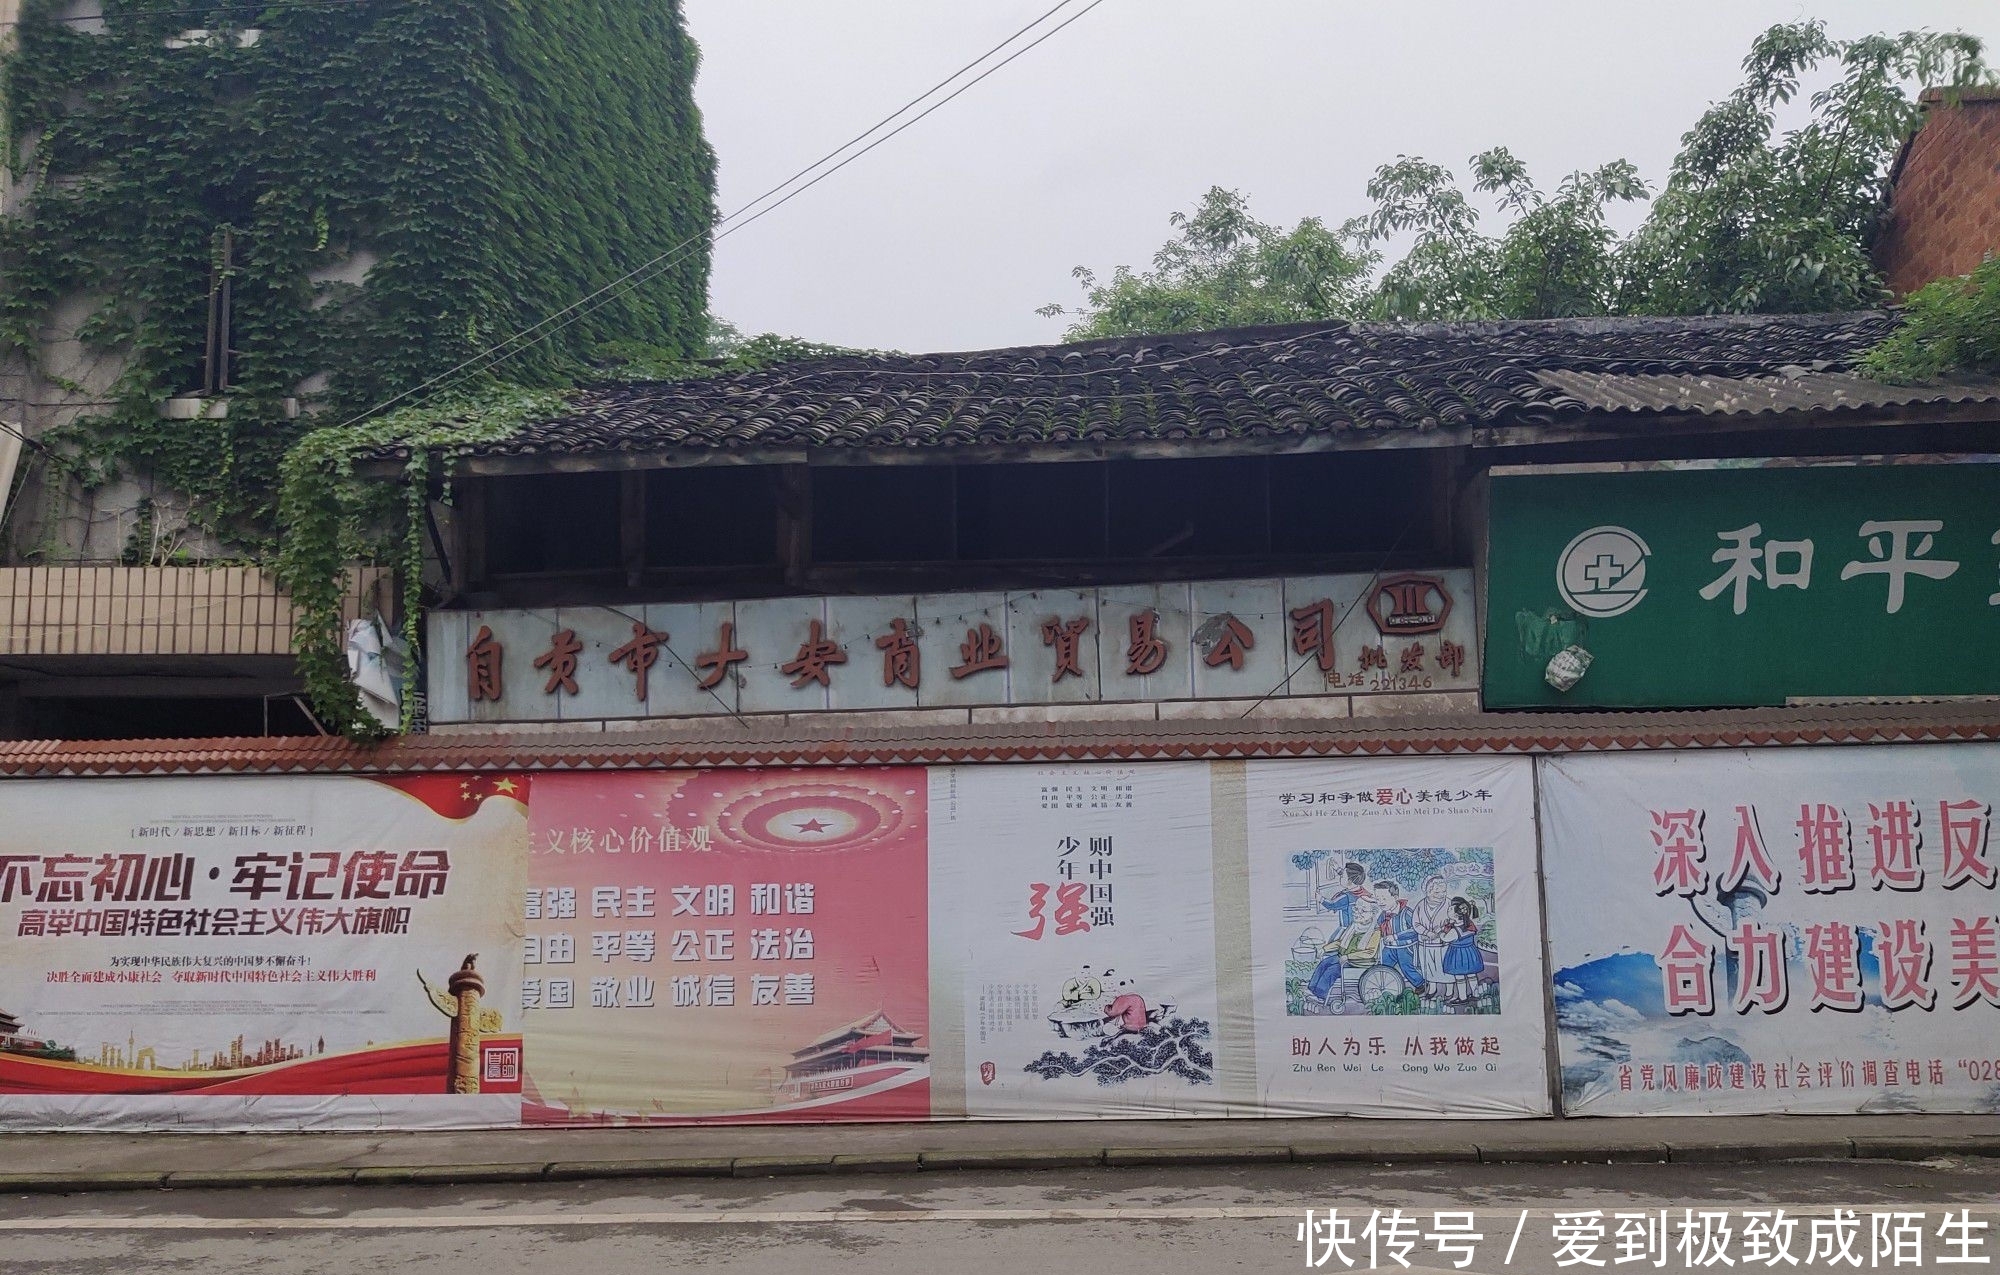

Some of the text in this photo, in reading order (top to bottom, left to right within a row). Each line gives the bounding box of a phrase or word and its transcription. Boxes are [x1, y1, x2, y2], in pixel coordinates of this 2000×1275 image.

[1699, 520, 2000, 615] 和平
[1325, 671, 1432, 691] 电话 221346
[1279, 788, 1493, 805] 学习和争做爱心美德少年
[1316, 809, 1328, 817] He
[1331, 809, 1359, 818] Zheng
[1361, 808, 1380, 816] Zuo
[1383, 808, 1393, 816] Ai
[1395, 807, 1411, 816] Xin
[1414, 807, 1430, 815] Mei
[1433, 807, 1445, 815] De
[1448, 806, 1469, 815] Shao
[1472, 806, 1494, 814] Nian
[138, 827, 171, 838] 新时代
[183, 826, 216, 837] 新思想
[229, 826, 261, 837] 新目标
[273, 825, 306, 837] 新征程
[1650, 799, 1995, 897] 深入推进反
[1056, 836, 1081, 880] 少年
[1090, 836, 1115, 926] 则中国强
[592, 886, 656, 918] 民主
[671, 885, 735, 916] 文明
[750, 883, 815, 915] 和谐
[18, 907, 411, 937] 高举中国特色社会主义伟大旗帜
[592, 931, 655, 962] 平等
[671, 929, 734, 961] 公正
[750, 928, 815, 960] 法治
[47, 969, 376, 984] 决胜全面建成小康社会 夺取新时代中国特色社会主义伟大胜利
[1660, 916, 2000, 1017] 合力建设美
[592, 976, 655, 1008] 敬业
[671, 974, 735, 1007] 诚信
[750, 973, 815, 1006] 友善
[1291, 1036, 1501, 1056] 助人为乐 从我做起
[1292, 1063, 1497, 1074] Zhu Ren Wei Le Cong Wo Zuo Qi
[1618, 1059, 1943, 1092] 省党风廉政建设社会评价调查电话
